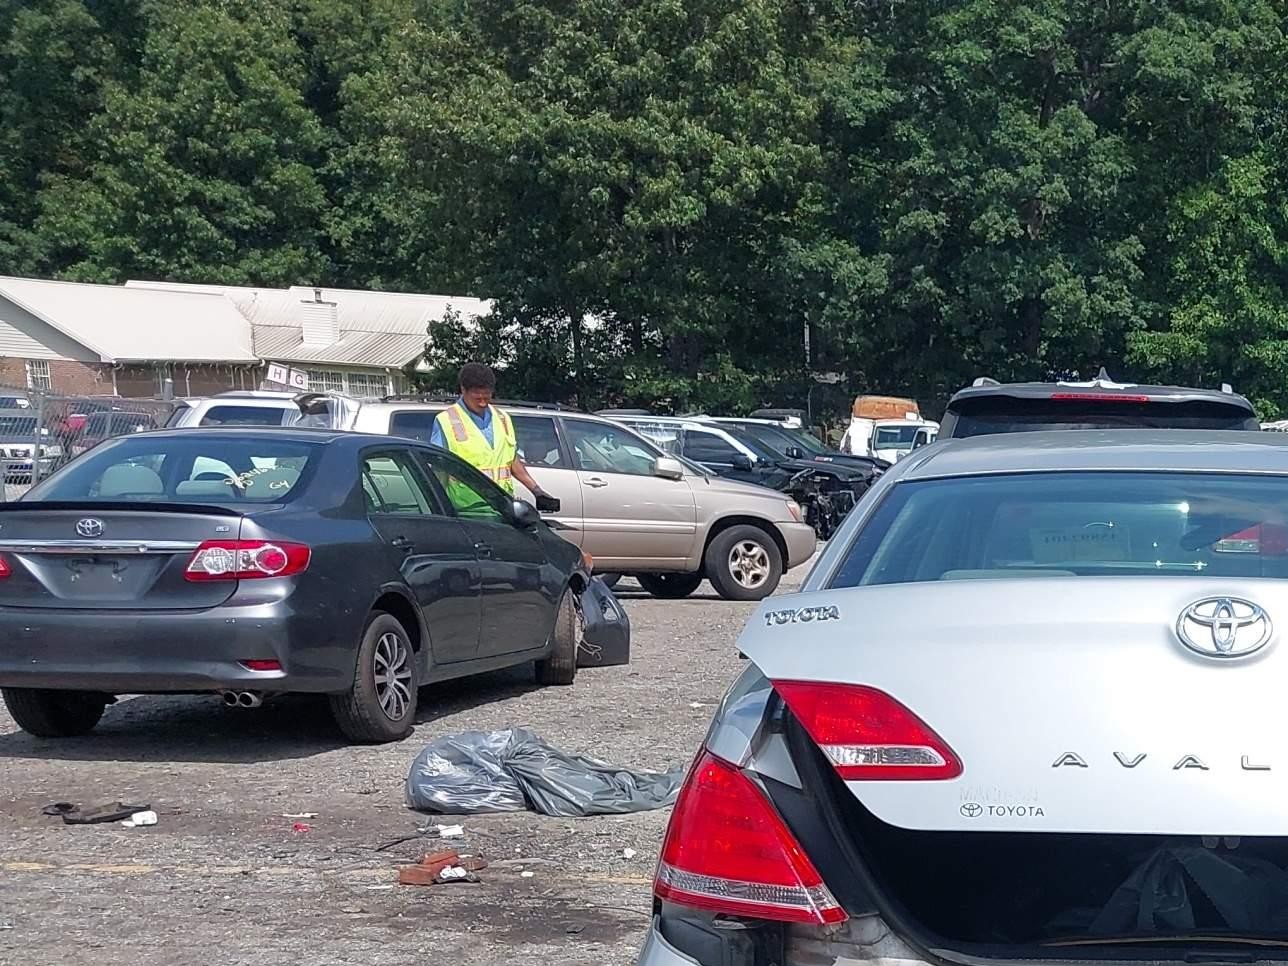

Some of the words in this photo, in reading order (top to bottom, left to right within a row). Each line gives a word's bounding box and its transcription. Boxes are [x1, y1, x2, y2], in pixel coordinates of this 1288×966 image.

[273, 368, 282, 380] H
[295, 374, 304, 385] G
[765, 605, 840, 626] TOYOTA
[987, 805, 1045, 817] TOYOTA
